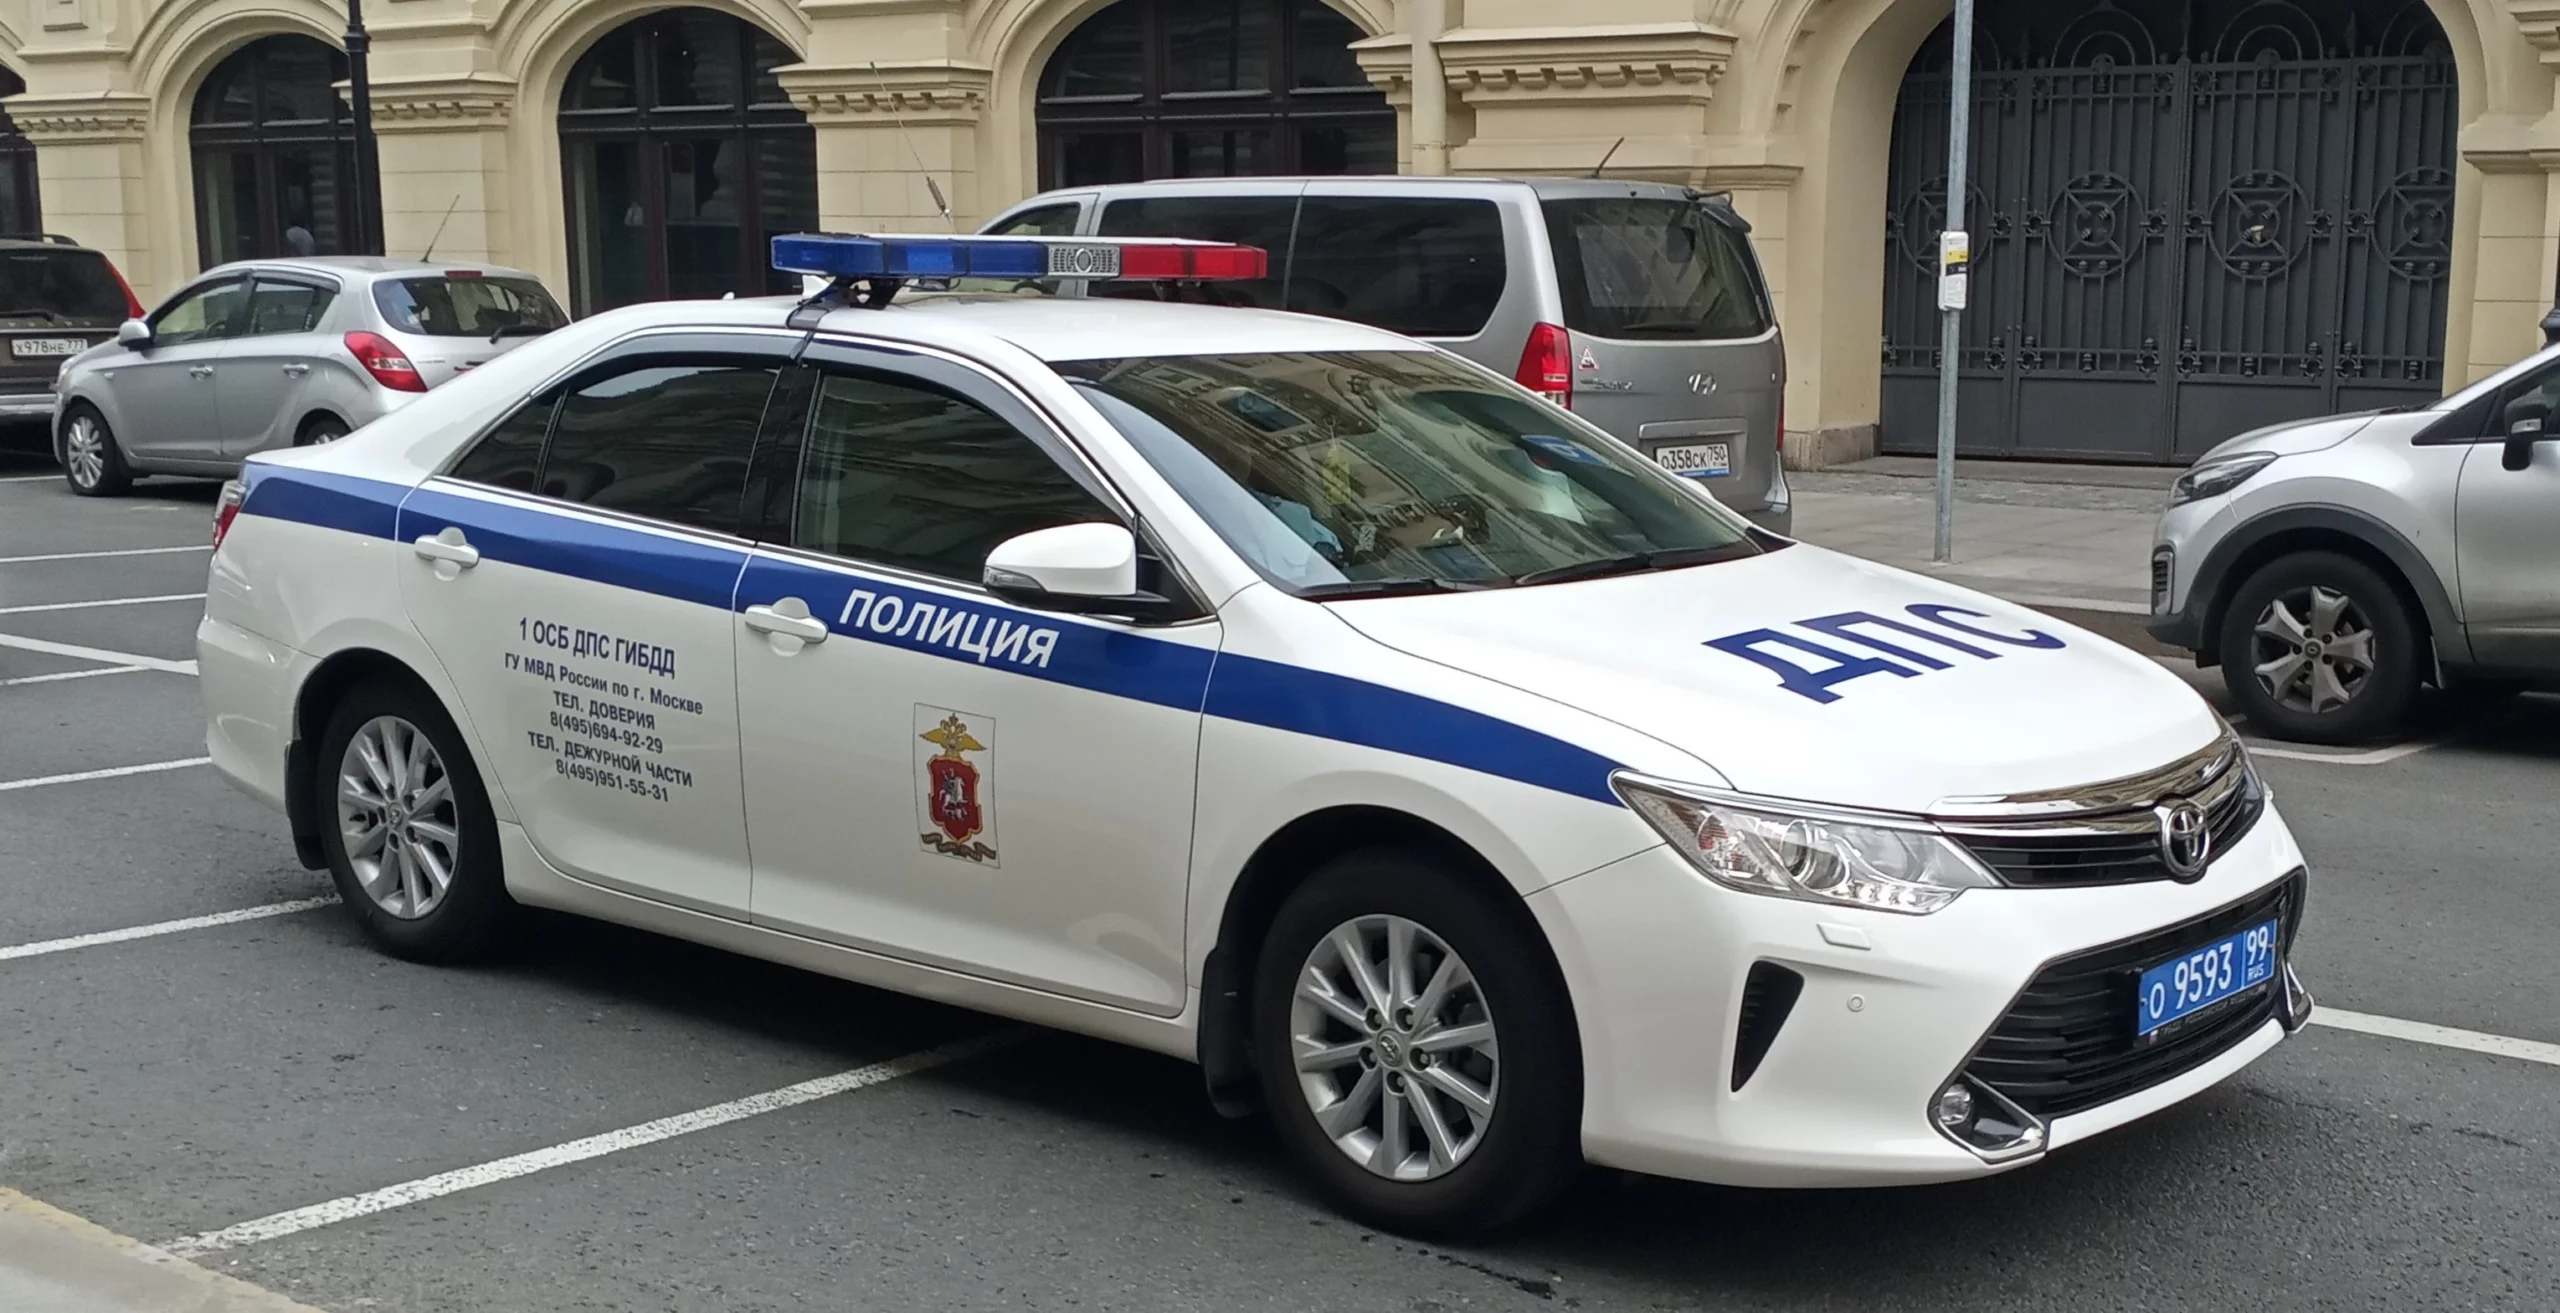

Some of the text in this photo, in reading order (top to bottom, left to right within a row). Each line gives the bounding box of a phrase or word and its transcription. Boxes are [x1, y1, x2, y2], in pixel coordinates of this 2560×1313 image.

[66, 340, 84, 349] 777
[1707, 445, 1726, 461] 750
[519, 617, 675, 680] 1 ОСБ ДПС ГИБДД
[838, 588, 1060, 668] ПОЛИЦИЯ
[1700, 603, 2067, 704] ДПС
[504, 652, 703, 715] ГУ МВД России по г. Москве
[550, 711, 663, 754] 8(495)694-92-29
[553, 690, 655, 730] ТЕЛ. ДОВЕРИЯ
[527, 731, 693, 788] ТЕЛ. ДЕЖУРНОЙ ЧАСТИ
[555, 758, 669, 802] 8(495)951-55-31
[2174, 942, 2233, 1010] 9593
[2246, 926, 2269, 966] 99
[2247, 963, 2265, 981] RUS
